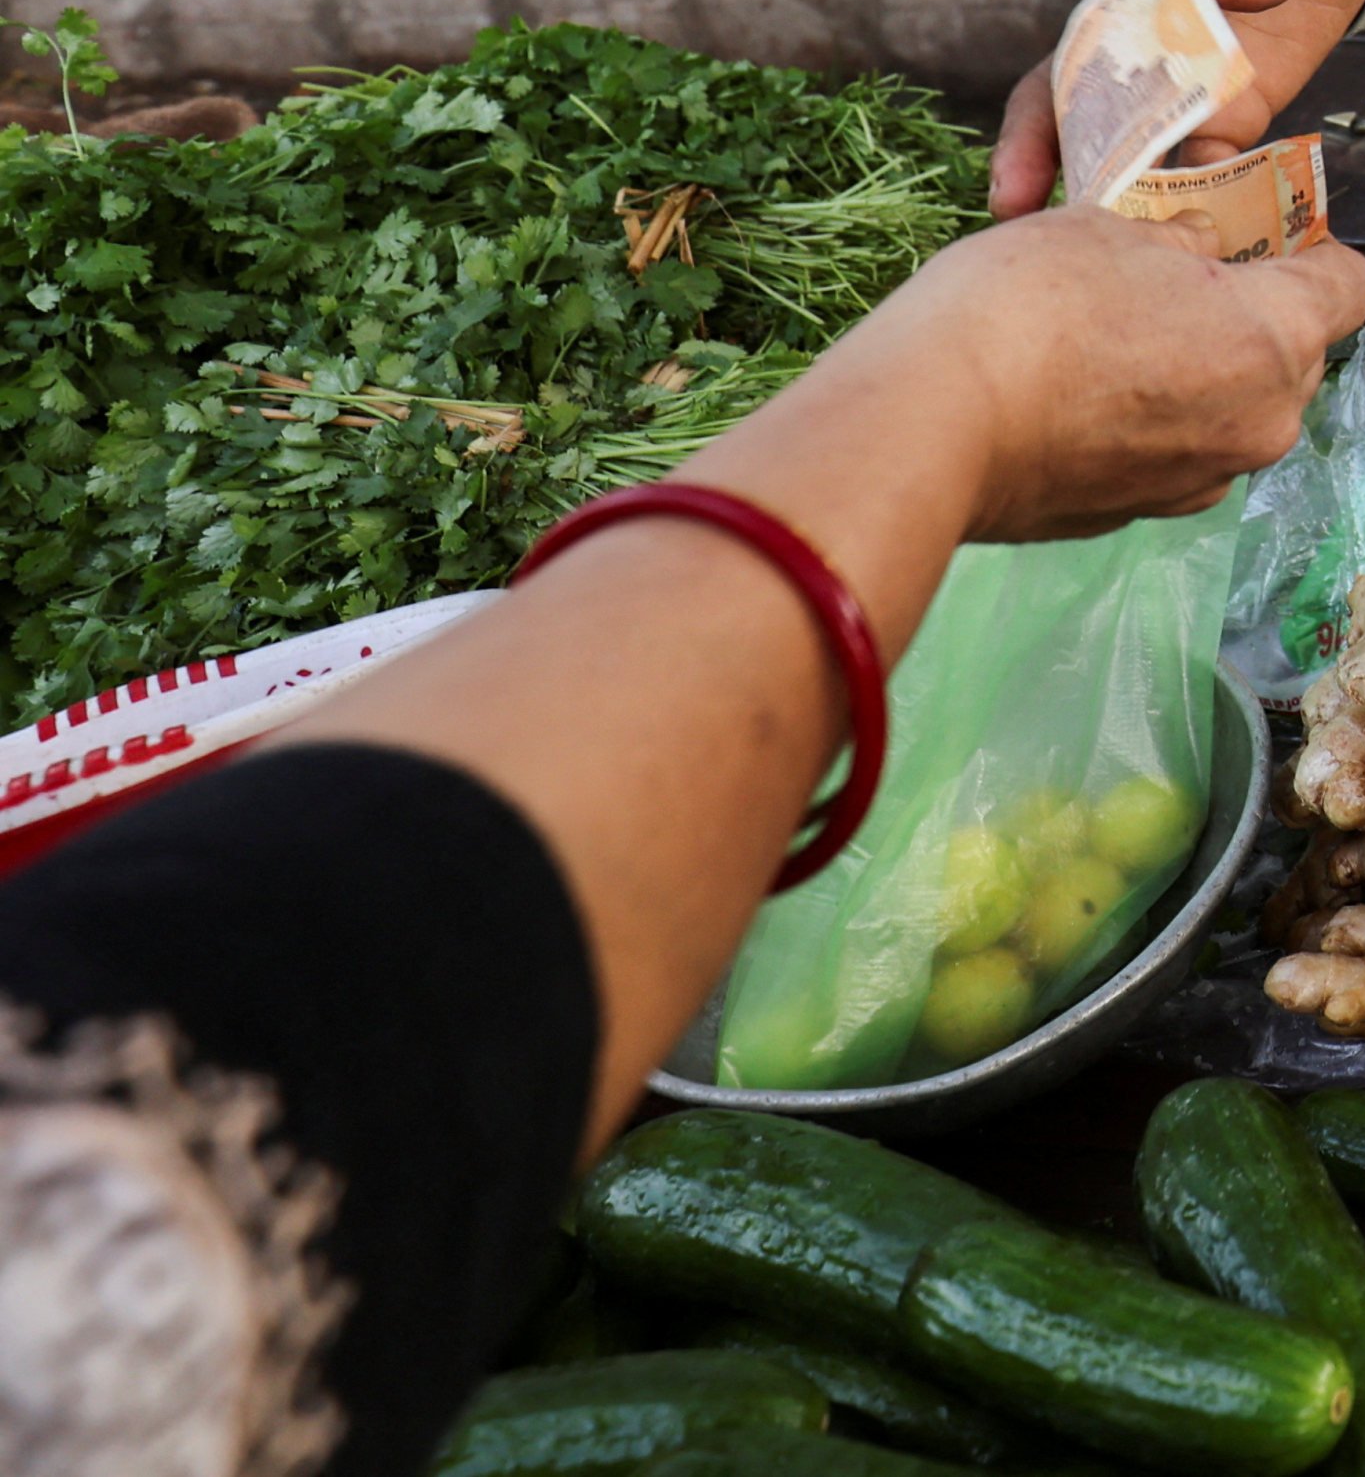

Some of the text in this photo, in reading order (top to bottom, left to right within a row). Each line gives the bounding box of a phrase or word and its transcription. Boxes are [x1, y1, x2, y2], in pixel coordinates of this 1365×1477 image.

[1167, 174, 1209, 190] BANK
[1211, 172, 1230, 183] OF
[1233, 154, 1269, 176] INDIA
